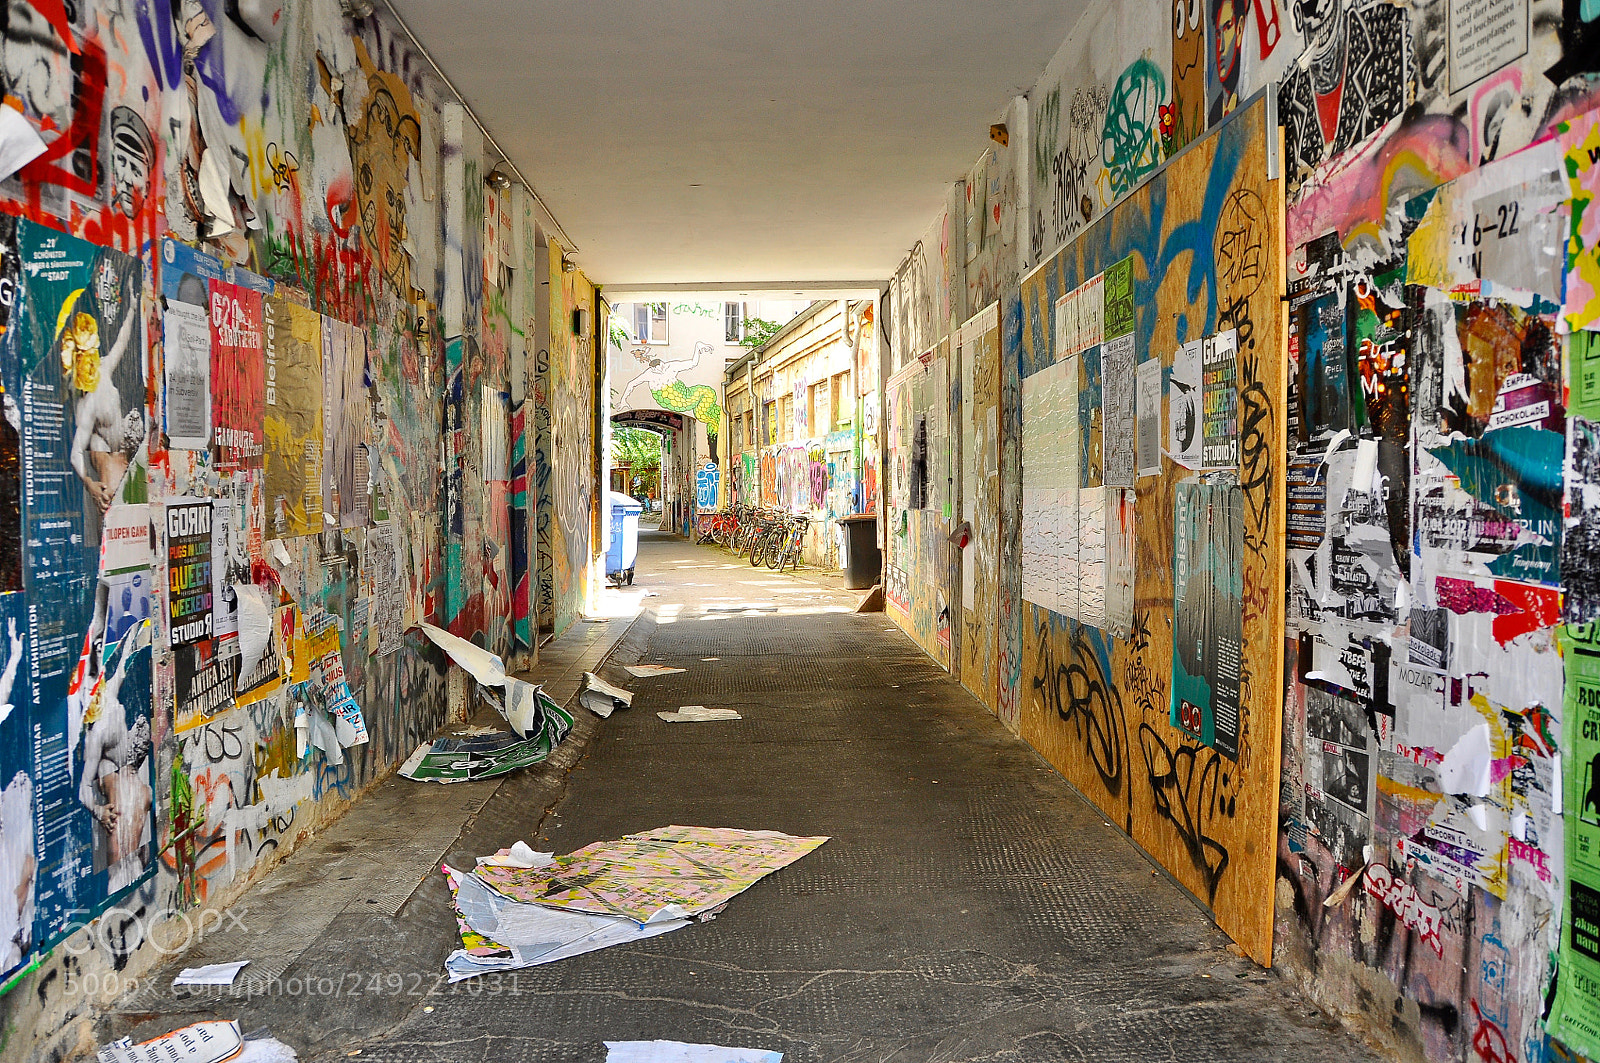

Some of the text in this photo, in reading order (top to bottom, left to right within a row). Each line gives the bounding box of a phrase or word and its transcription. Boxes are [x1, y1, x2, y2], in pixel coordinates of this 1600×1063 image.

[1456, 19, 1516, 59] Glanz empfangen.
[1460, 27, 1472, 43] und
[48, 271, 70, 281] STADT
[212, 292, 239, 330] G20
[265, 302, 276, 406] Bleifrei?
[214, 427, 254, 448] HAMBURG
[24, 426, 34, 506] HEDONISTIC
[1204, 445, 1229, 461] STUDIO
[131, 525, 148, 538] GANG
[169, 541, 210, 560] PUGS IN LOVE
[170, 561, 210, 596] QUEER
[170, 592, 212, 618] WEEKEND
[28, 604, 40, 679] EXHIBITION
[172, 620, 204, 645] STUDIO
[192, 658, 232, 699] ANTIFA IST
[32, 682, 40, 705] ART
[34, 723, 42, 780] SEMINAR
[36, 784, 46, 861] HEDONISTIC
[1576, 933, 1599, 954] naru
